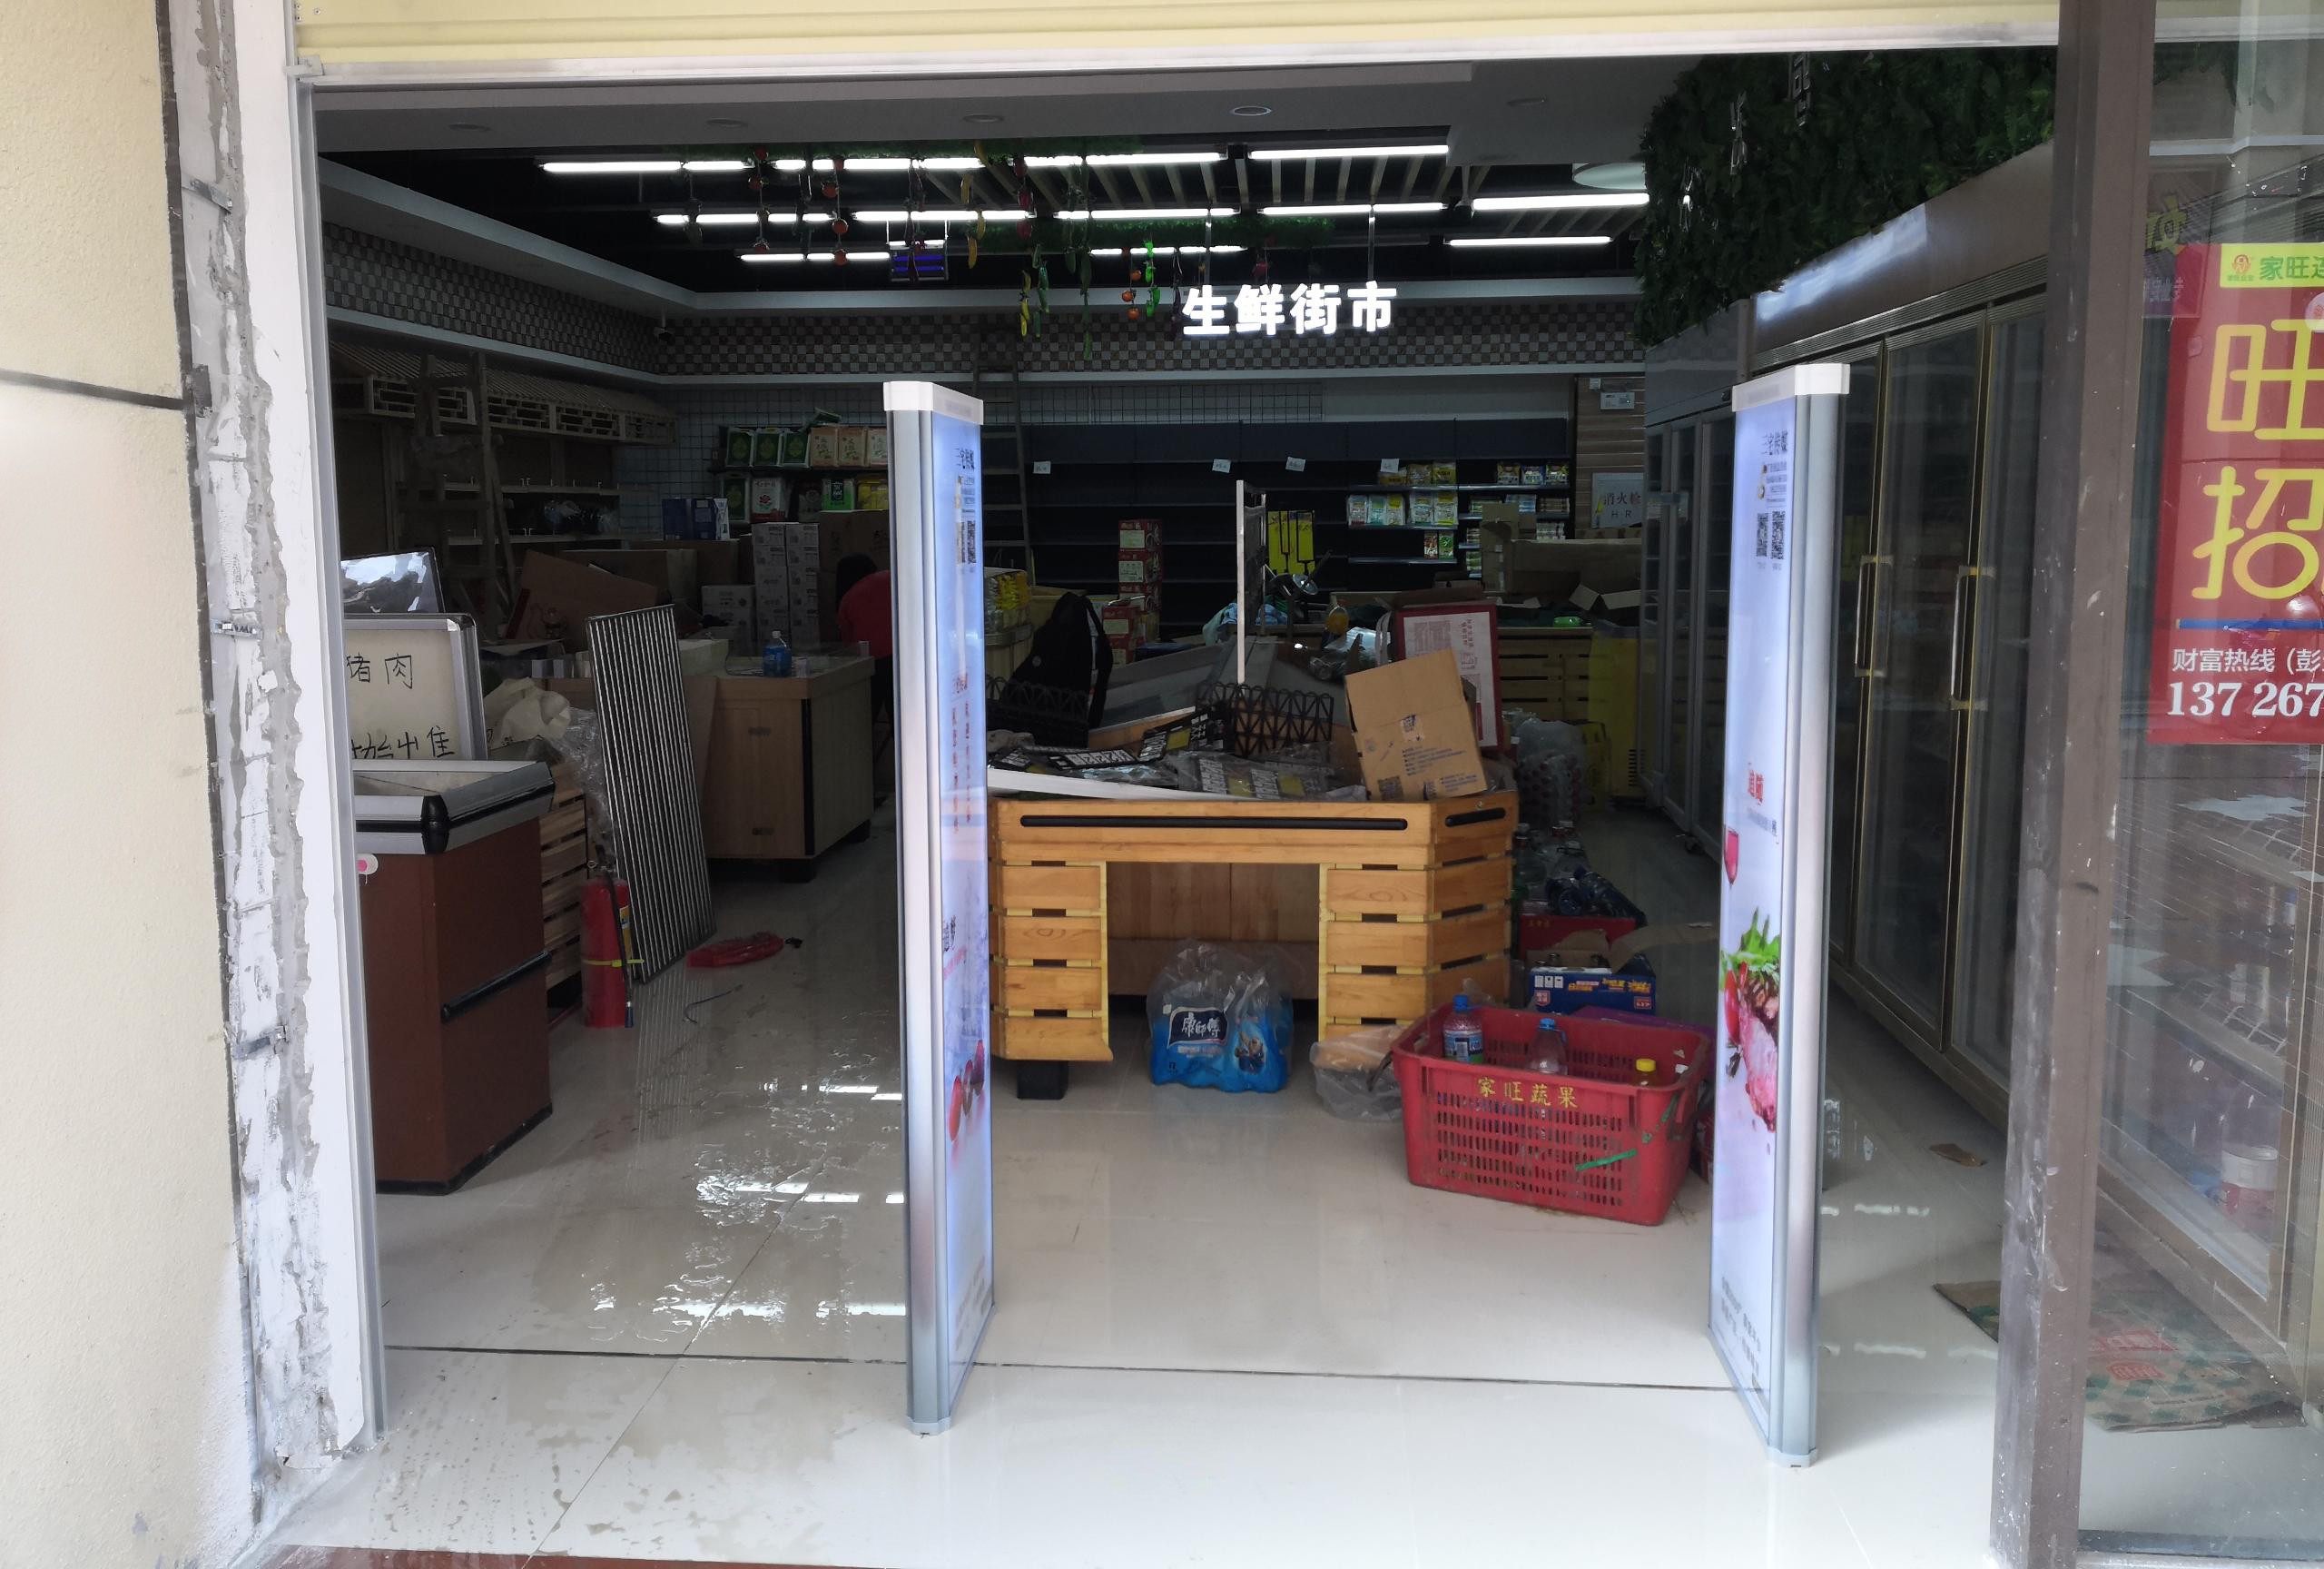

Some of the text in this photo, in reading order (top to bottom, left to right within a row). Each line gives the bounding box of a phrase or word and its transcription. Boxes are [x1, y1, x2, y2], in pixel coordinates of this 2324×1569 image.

[1182, 281, 1397, 336] 生鲜街市
[2207, 319, 2324, 440] 旺
[2191, 465, 2324, 599] 招
[2172, 647, 2324, 675] 财富热线（彭
[2167, 682, 2324, 717] 137 267
[1477, 1077, 1578, 1109] 家旺蔬果
